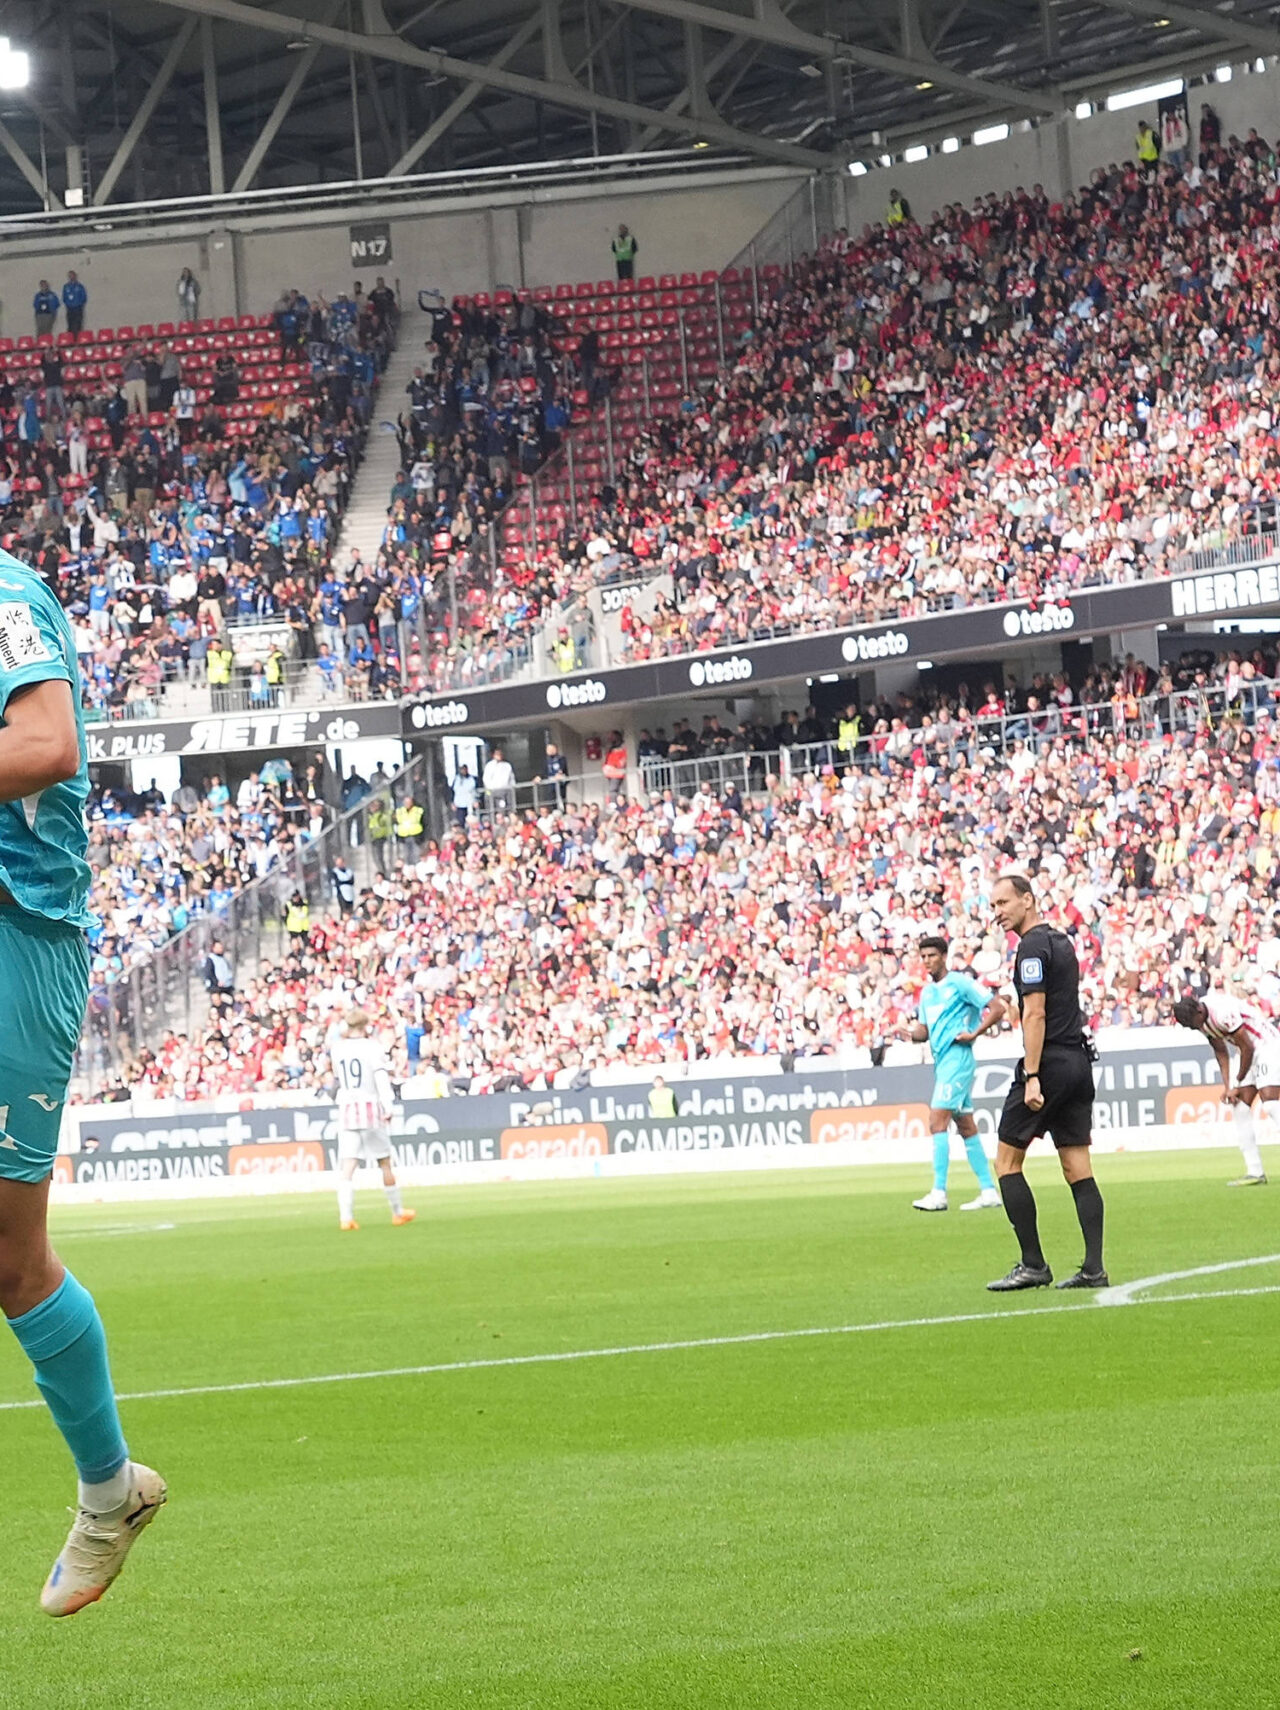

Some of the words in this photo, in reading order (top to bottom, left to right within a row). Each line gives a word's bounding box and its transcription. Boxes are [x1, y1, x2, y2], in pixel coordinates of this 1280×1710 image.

[351, 240, 387, 257] N17
[1019, 605, 1074, 634] testo
[858, 630, 908, 657] testo
[703, 656, 752, 683] testo
[560, 679, 606, 706] testo
[425, 700, 468, 726] testo
[111, 733, 166, 757] PLUS
[339, 1057, 362, 1090] 19
[614, 1124, 725, 1154] CAMPER
[729, 1119, 804, 1147] VANS
[818, 1109, 925, 1144] carado
[507, 1128, 601, 1160] carado
[76, 1157, 163, 1184] CAMPER
[165, 1154, 225, 1180] VANS
[234, 1146, 320, 1176] carado
